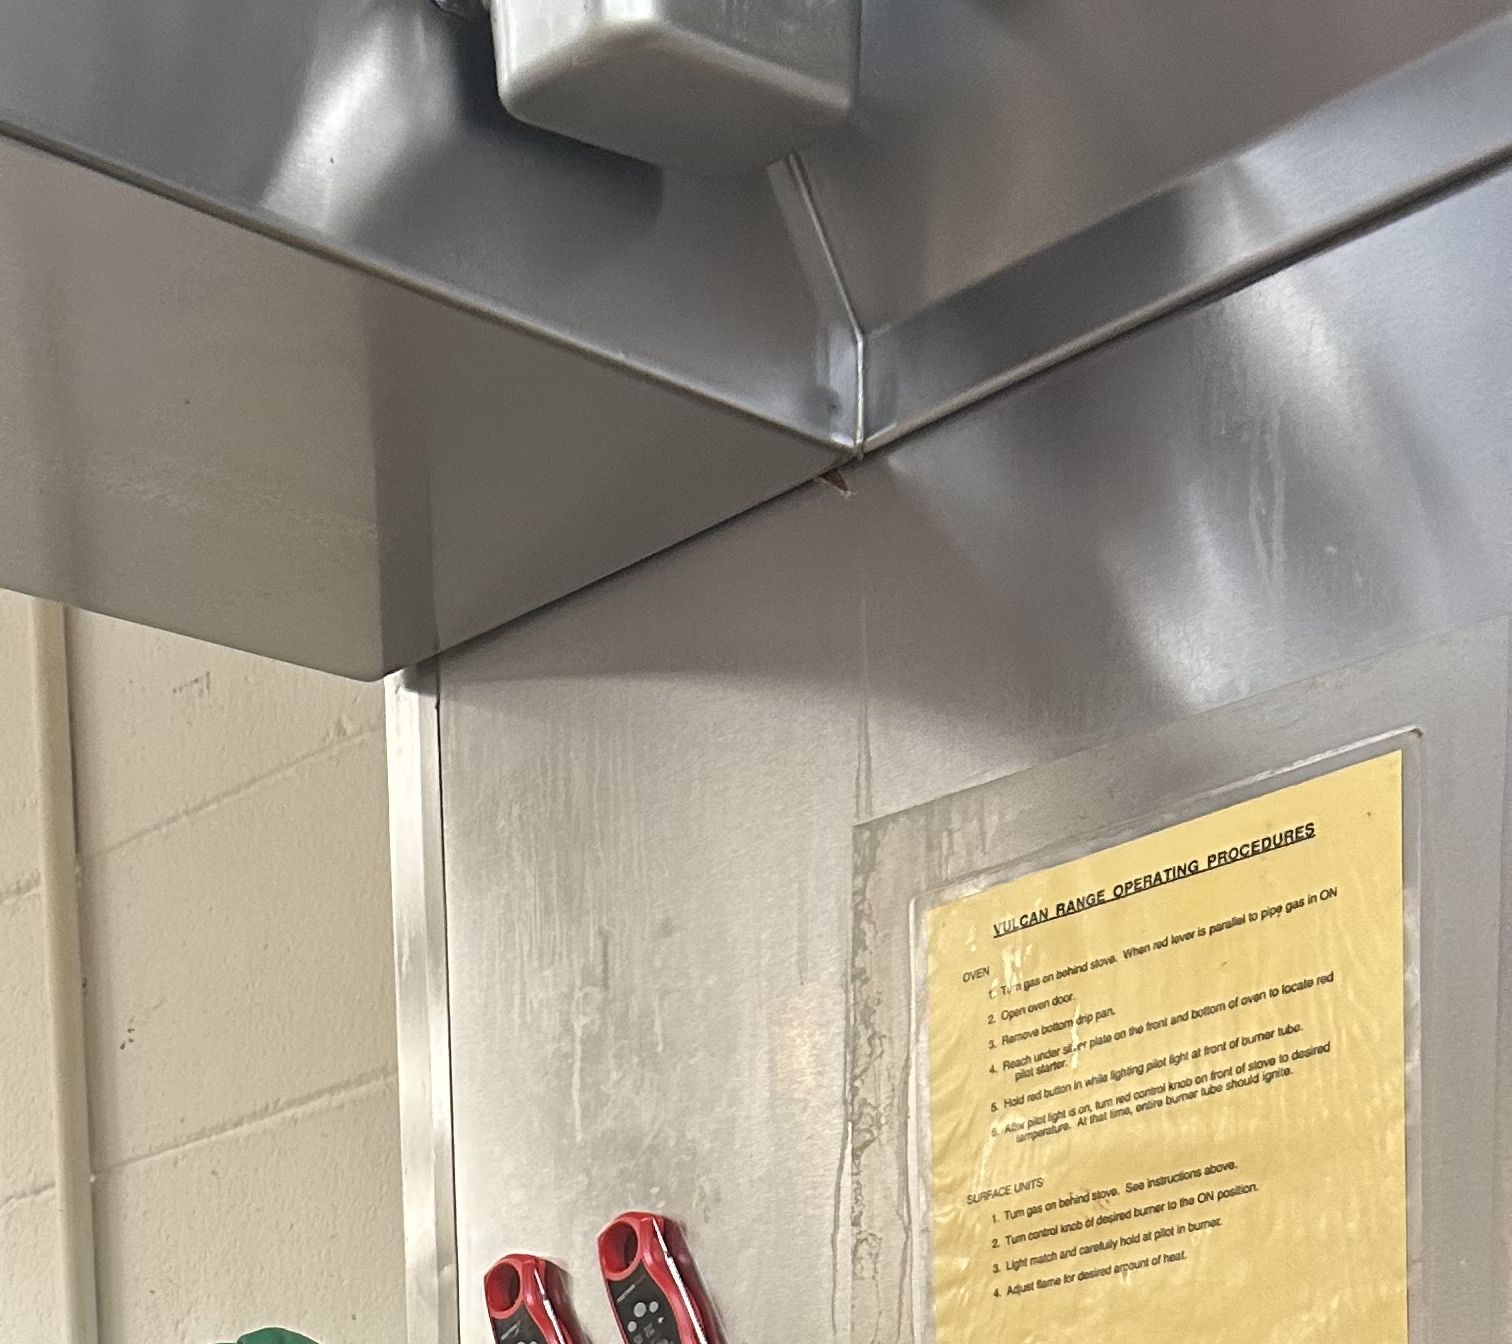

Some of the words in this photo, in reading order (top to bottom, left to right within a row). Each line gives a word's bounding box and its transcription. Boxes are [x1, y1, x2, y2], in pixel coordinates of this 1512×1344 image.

[993, 907, 1048, 937] VULCAN
[1055, 889, 1105, 917] RANGE
[1112, 859, 1200, 899] OPERATING
[1207, 822, 1314, 869] PROCEDURES
[1023, 977, 1040, 991] gas
[1041, 973, 1054, 983] on
[1055, 961, 1088, 979] behind
[1090, 954, 1117, 969] stove.
[1122, 944, 1150, 959] When
[1152, 936, 1168, 949] red
[1170, 930, 1195, 944] lever
[1197, 926, 1206, 937] is
[1208, 913, 1245, 936] parallel
[1247, 912, 1258, 922] to
[1260, 904, 1282, 920] pipe
[1284, 898, 1304, 913] gas
[1307, 893, 1317, 904] in
[1319, 886, 1337, 900] ON
[962, 965, 989, 982] OVEN
[987, 1014, 996, 1024] 2.
[1000, 1006, 1026, 1021] Open
[1027, 999, 1050, 1013] oven
[1051, 993, 1076, 1006] door.
[988, 1064, 997, 1074] 4.
[1002, 1055, 1031, 1071] Reach
[1033, 1047, 1059, 1062] under
[1089, 1034, 1112, 1049] plate
[1113, 1029, 1126, 1040] on
[1128, 1024, 1144, 1036] the
[1145, 1017, 1167, 1031] front
[1170, 1010, 1188, 1025] and
[1190, 1002, 1226, 1019] bottom
[1227, 996, 1239, 1009] of
[1240, 991, 1266, 1005] oven
[1268, 987, 1279, 998] to
[1281, 978, 1314, 994] locate
[1316, 970, 1334, 985] red
[988, 1039, 997, 1049] 3.
[1001, 1028, 1039, 1045] Remove
[1040, 1019, 1073, 1035] bottom
[1094, 1007, 1115, 1022] pan.
[990, 1101, 998, 1112] 5.
[1003, 1094, 1024, 1108] Hold
[1026, 1089, 1042, 1102] red
[1043, 1083, 1071, 1098] button
[1073, 1080, 1082, 1090] in
[1084, 1073, 1107, 1087] while
[1110, 1064, 1144, 1081] lighting
[1145, 1057, 1166, 1073] pilot
[1168, 1051, 1189, 1066] light
[1191, 1047, 1201, 1059] at
[1203, 1041, 1226, 1056] front
[1228, 1036, 1239, 1049] of
[1241, 1029, 1275, 1046] burner
[1277, 1023, 1303, 1036] tube.
[1014, 1067, 1034, 1082] pilot
[1035, 1059, 1067, 1074] starter.
[1027, 1114, 1046, 1129] pilot
[1047, 1109, 1066, 1123] light
[1068, 1107, 1076, 1117] is
[1077, 1104, 1092, 1114] on,
[1094, 1098, 1113, 1110] turn
[1115, 1091, 1131, 1104] red
[1133, 1082, 1165, 1100] control
[1167, 1078, 1192, 1091] knob
[1194, 1073, 1208, 1084] on
[1210, 1066, 1232, 1080] front
[1234, 1061, 1245, 1074] of
[1247, 1057, 1276, 1071] stove
[1278, 1053, 1289, 1063] to
[1291, 1040, 1330, 1060] desired
[1015, 1122, 1070, 1142] temperature.
[1076, 1116, 1087, 1127] At
[1089, 1111, 1107, 1124] that
[1109, 1106, 1132, 1119] time,
[1135, 1099, 1163, 1112] entire
[1165, 1089, 1198, 1105] burner
[1200, 1084, 1222, 1096] tube
[1225, 1073, 1259, 1090] should
[1262, 1067, 1293, 1083] ignite.
[966, 1184, 1011, 1204] SURFACE
[1013, 1177, 1044, 1193] UNITS
[991, 1213, 999, 1223] 1.
[1003, 1209, 1024, 1220] Turn
[1026, 1204, 1042, 1218] gas
[1044, 1201, 1056, 1211] on
[1058, 1190, 1090, 1208] behind
[1091, 1187, 1119, 1201] stove.
[1125, 1181, 1144, 1193] See
[1147, 1168, 1201, 1188] instructions
[1203, 1161, 1237, 1175] above.
[991, 1238, 1000, 1248] 2.
[1004, 1233, 1026, 1245] Turn
[1027, 1224, 1058, 1240] control
[1059, 1220, 1083, 1233] knob
[1084, 1216, 1094, 1228] of
[1095, 1209, 1131, 1226] desired
[1133, 1203, 1165, 1217] burner
[1167, 1200, 1177, 1210] to
[1179, 1197, 1194, 1207] the
[1196, 1190, 1214, 1203] ON
[1217, 1183, 1258, 1201] position.
[992, 1263, 1001, 1273] 3.
[1005, 1257, 1027, 1271] Light
[1029, 1251, 1057, 1265] match
[1059, 1246, 1076, 1259] and
[1078, 1239, 1117, 1255] carefully
[1119, 1233, 1140, 1246] hold
[1141, 1231, 1152, 1241] at
[1153, 1226, 1174, 1241] pilot
[1176, 1224, 1185, 1234] in
[1187, 1217, 1222, 1232] burner.
[992, 1287, 1001, 1297] 4.
[1006, 1281, 1034, 1295] Adjust
[1036, 1277, 1061, 1289] flame
[1063, 1273, 1075, 1284] for
[1077, 1265, 1111, 1281] desired
[1113, 1259, 1147, 1274] amount
[1150, 1254, 1161, 1265] of
[1162, 1250, 1187, 1263] heat.
